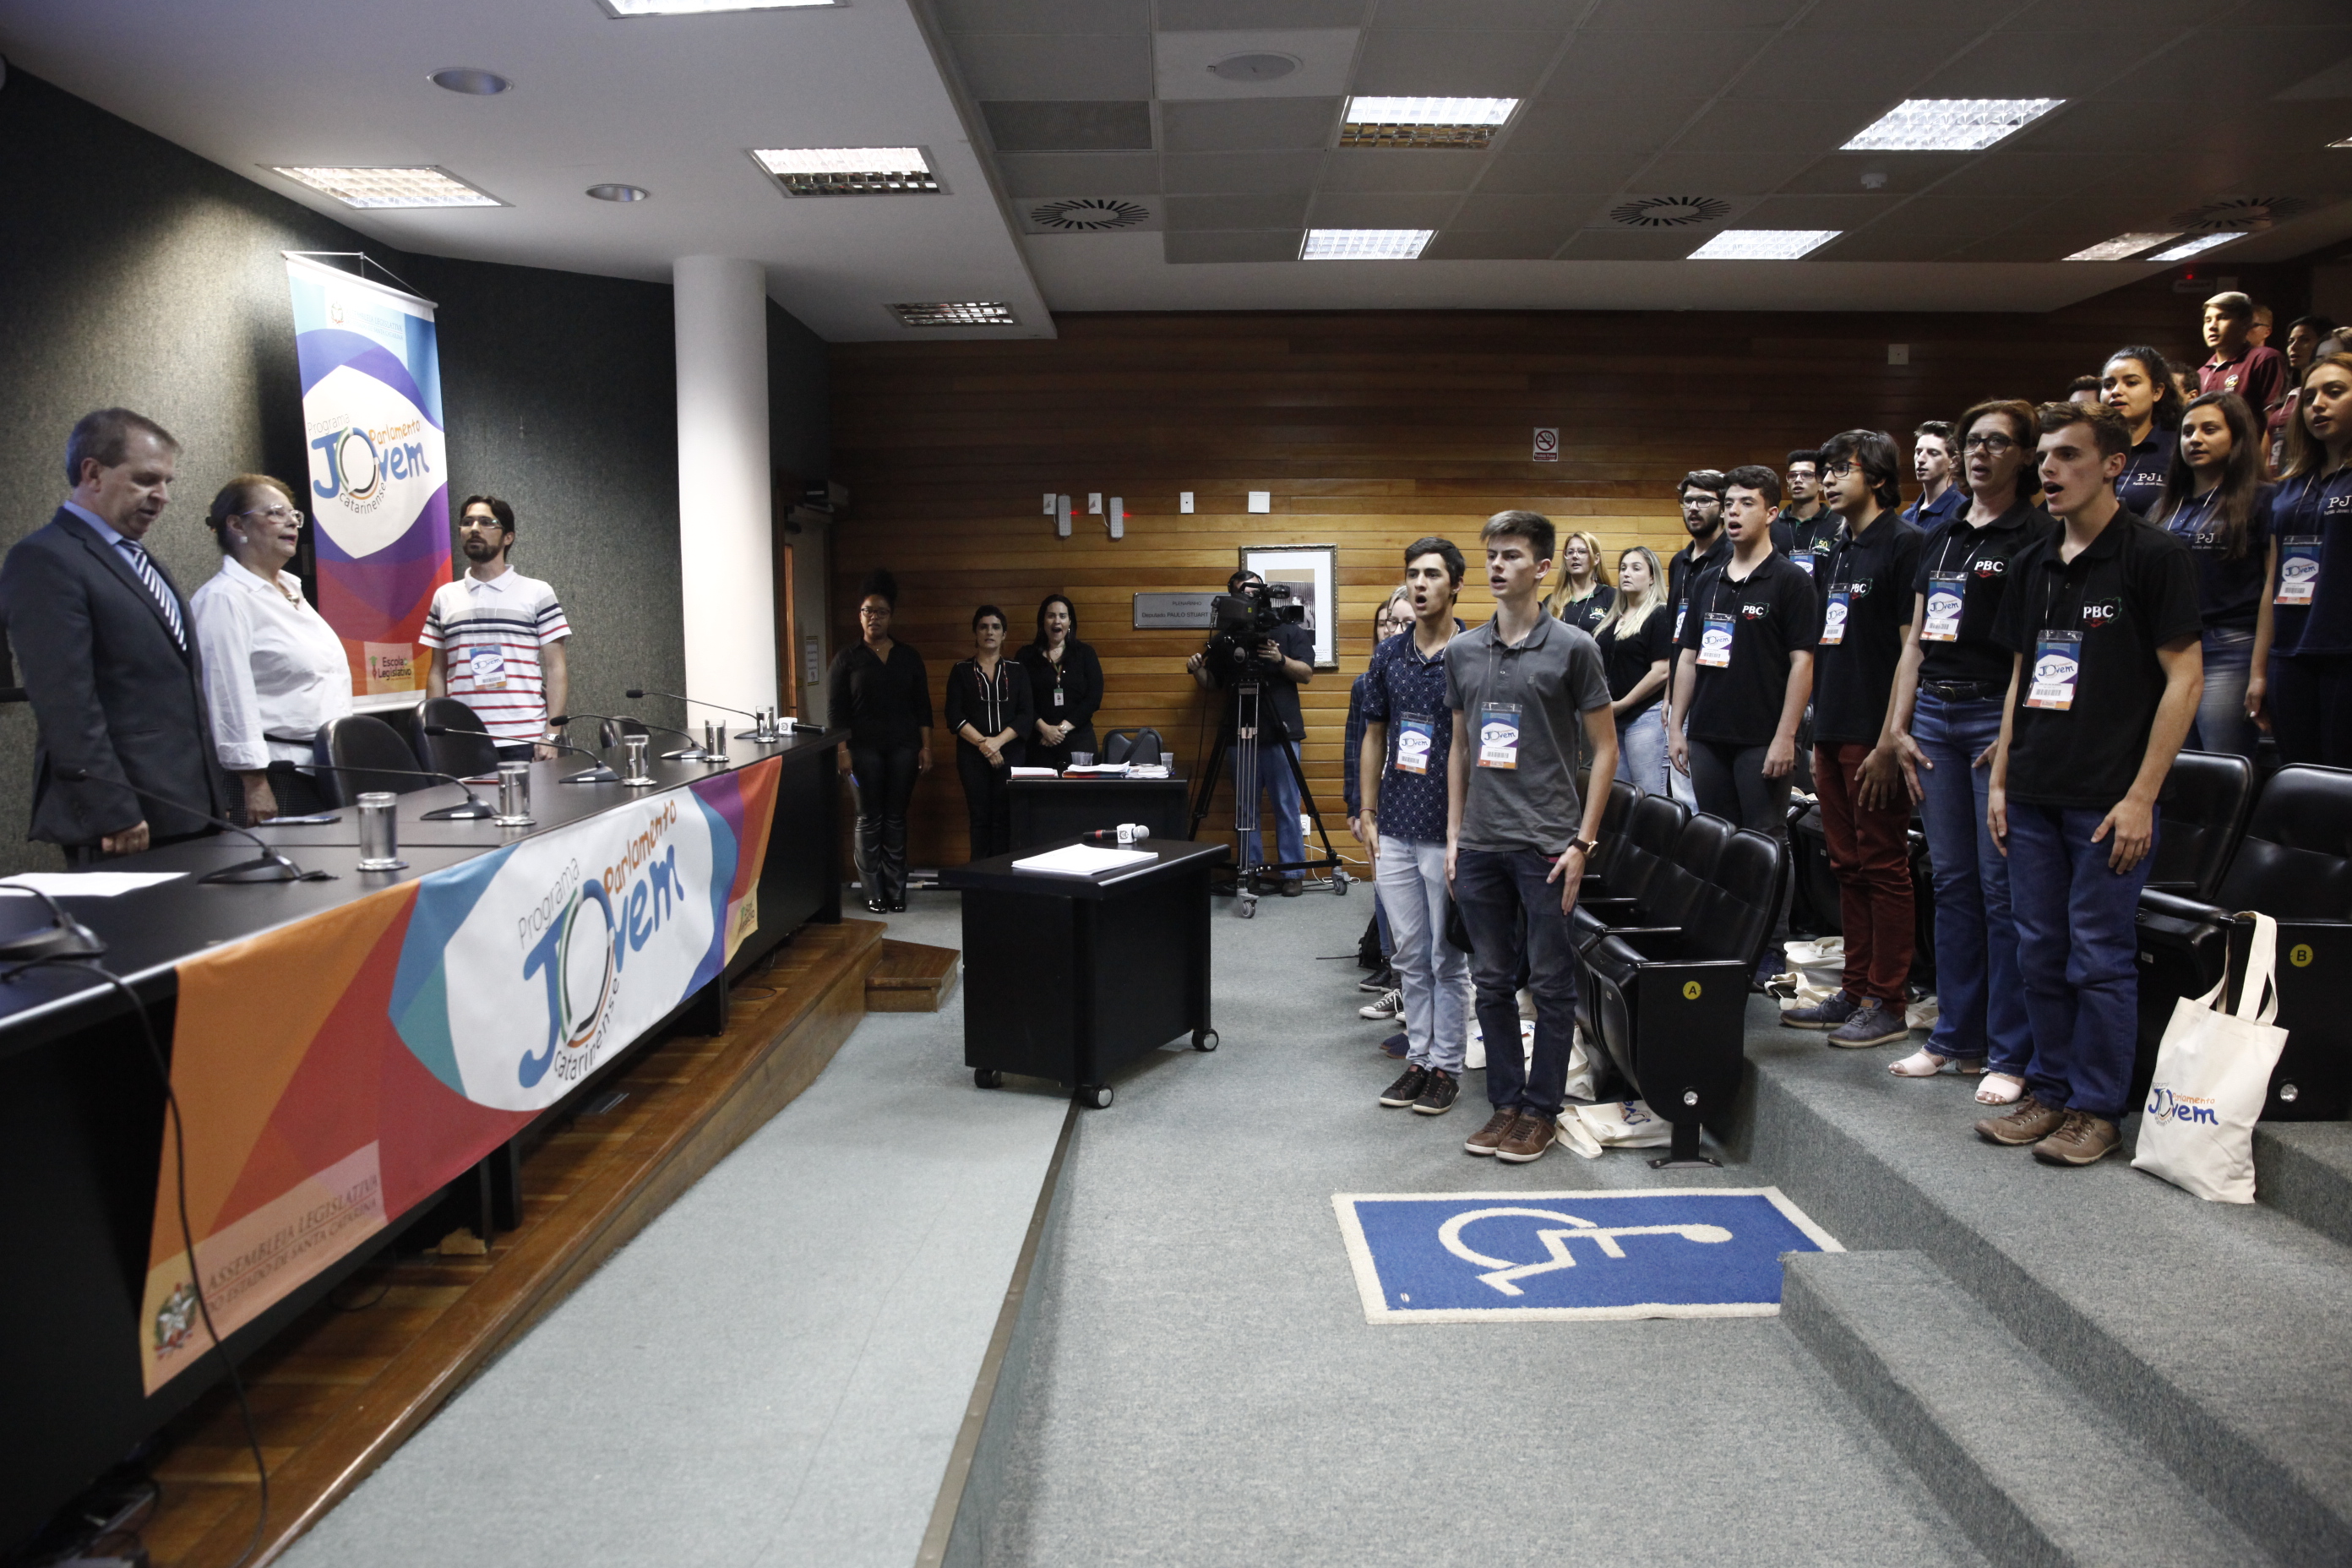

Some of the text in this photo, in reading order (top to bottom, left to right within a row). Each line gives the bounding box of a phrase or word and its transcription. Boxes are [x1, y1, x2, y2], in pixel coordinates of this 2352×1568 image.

[307, 413, 351, 436] Programa
[368, 419, 421, 445] Parlamento
[1974, 560, 2004, 572] PBC
[1850, 583, 1866, 593] PBC
[1742, 605, 1764, 615] PBC
[2083, 605, 2114, 618] PBC
[382, 656, 404, 667] Escola
[378, 667, 412, 680] Legislativo
[603, 799, 677, 896] Parlamento
[517, 857, 580, 950] Programa
[2296, 950, 2307, 961] B
[1688, 985, 1697, 995] A
[2172, 1092, 2215, 1104] Parlamento
[209, 1173, 378, 1290] ASSEMBLEIA LEGISLATIVA
[291, 1230, 327, 1260] SANTA
[328, 1198, 377, 1236] CATARINA
